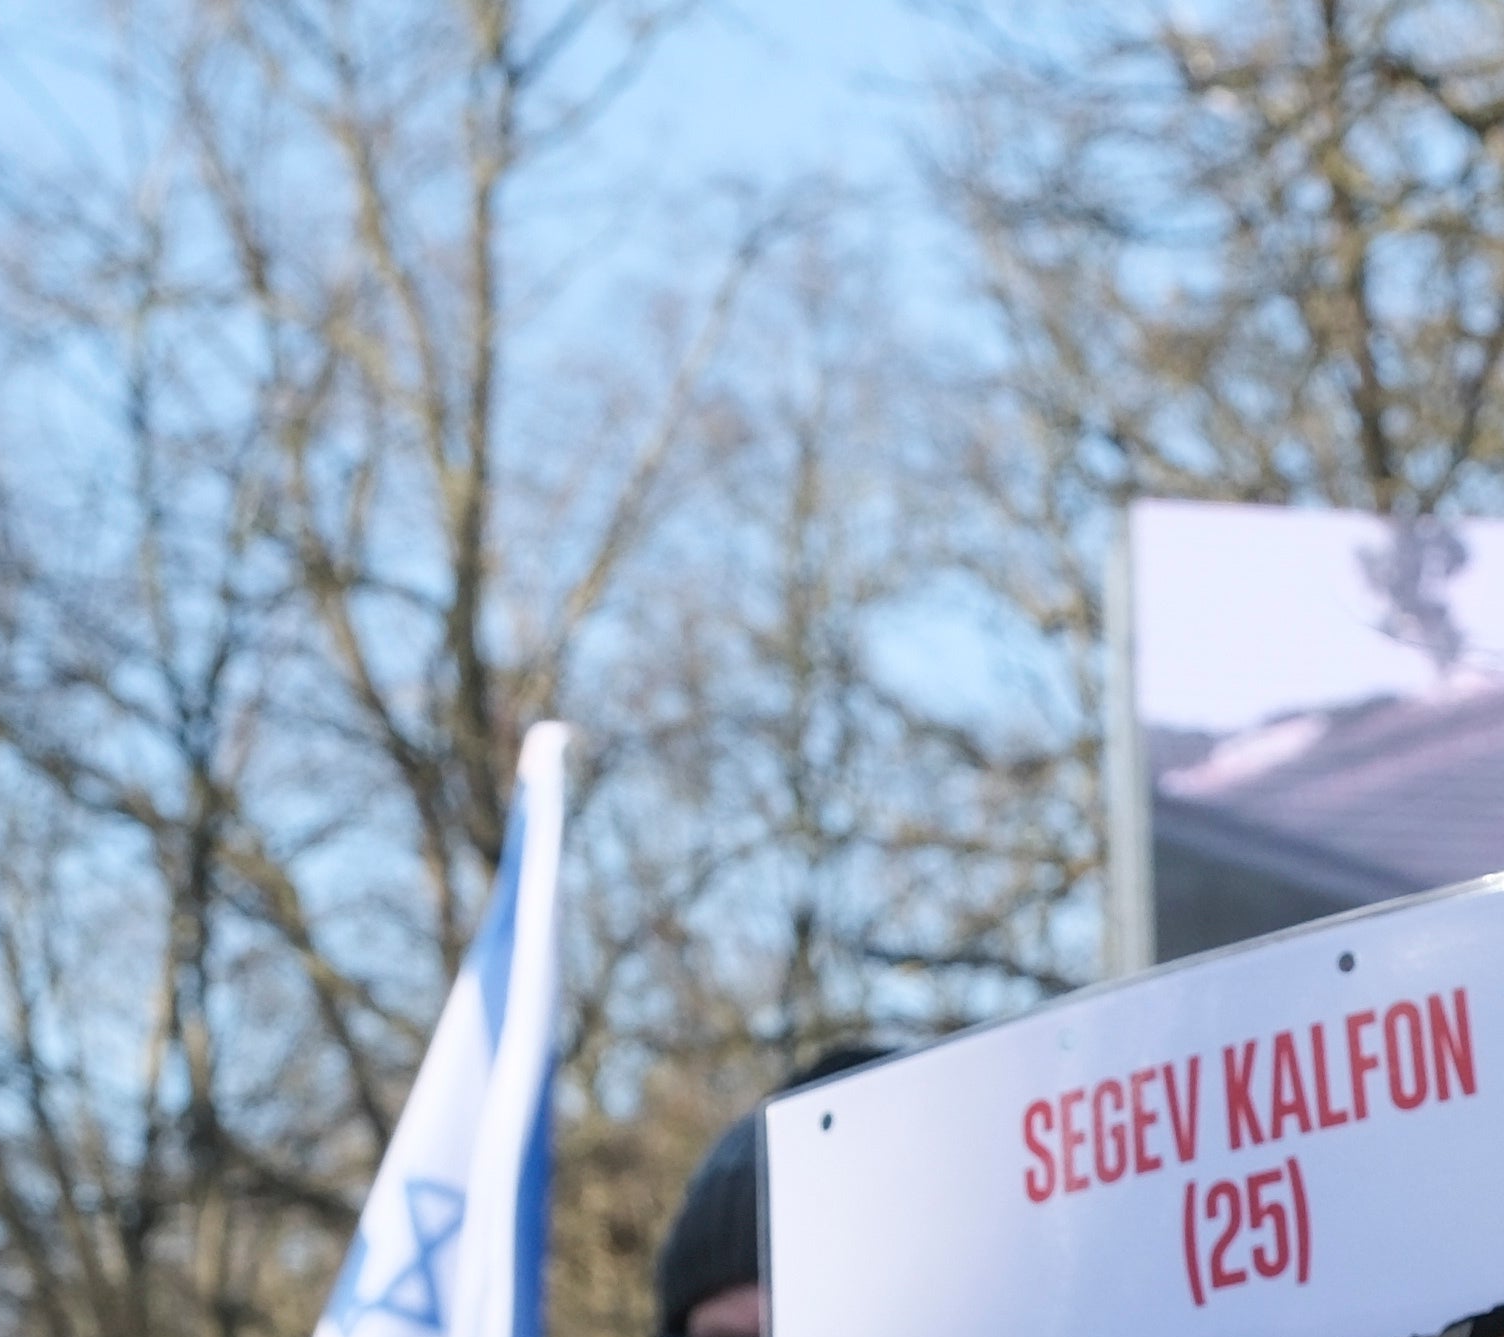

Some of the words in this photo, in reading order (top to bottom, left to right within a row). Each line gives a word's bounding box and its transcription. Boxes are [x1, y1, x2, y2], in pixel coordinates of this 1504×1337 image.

[1022, 1055, 1201, 1204] SEGEV
[1223, 987, 1477, 1151] KALFON
[1182, 1155, 1311, 1307] (25)
